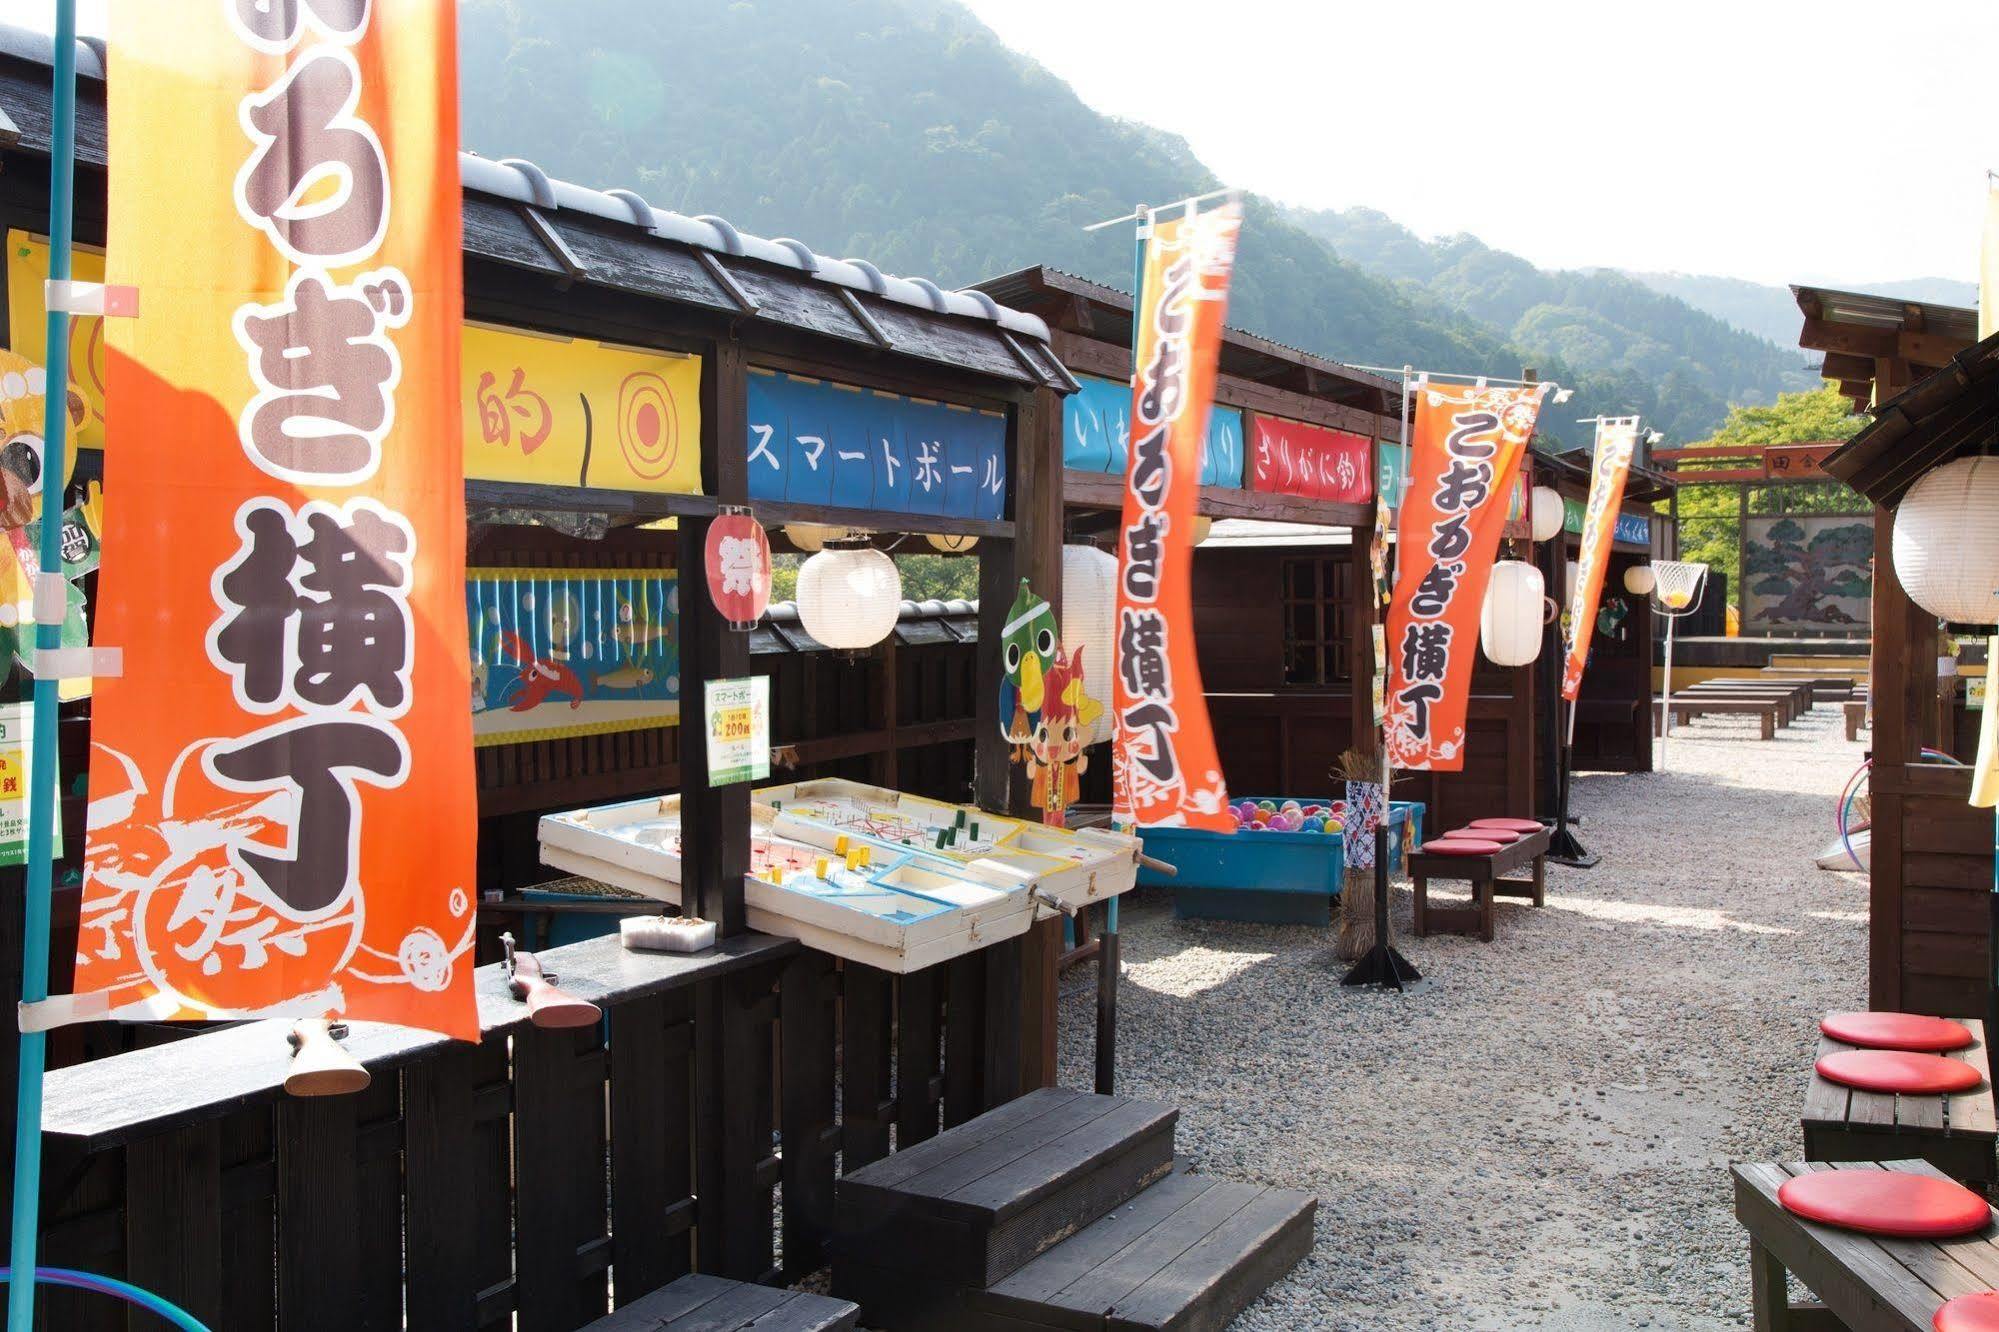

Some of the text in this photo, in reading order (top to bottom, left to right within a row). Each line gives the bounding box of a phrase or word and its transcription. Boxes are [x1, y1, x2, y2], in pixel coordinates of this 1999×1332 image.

[476, 366, 553, 456] 的
[210, 0, 410, 913] ろぎ横丁
[747, 424, 1003, 496] スマートボール
[719, 536, 762, 597] 祭
[1396, 411, 1500, 740] こおろぎ横丁
